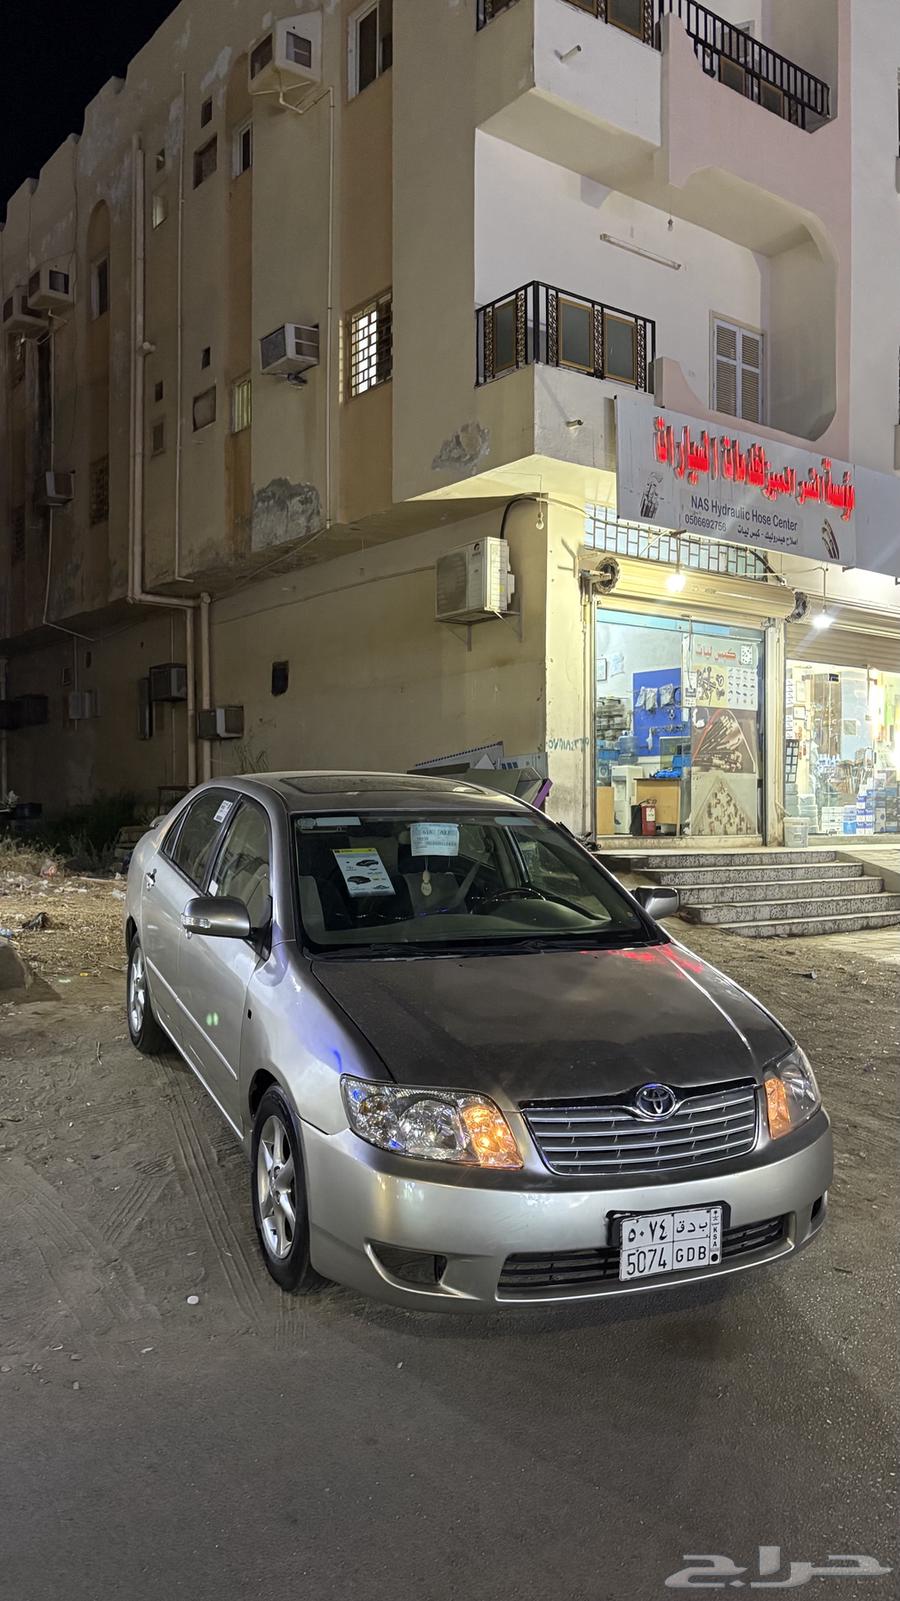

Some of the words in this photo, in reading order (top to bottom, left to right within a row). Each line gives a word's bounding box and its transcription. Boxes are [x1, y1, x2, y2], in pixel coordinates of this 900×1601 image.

[653, 416, 719, 487] السيارات
[691, 495, 709, 512] NAS
[711, 499, 750, 521] Hydraulic
[752, 509, 771, 525] Hose
[773, 514, 798, 532] Center
[628, 1219, 667, 1242] ٥٠٧٤
[627, 1247, 667, 1275] 5074
[676, 1245, 706, 1262] GDB
